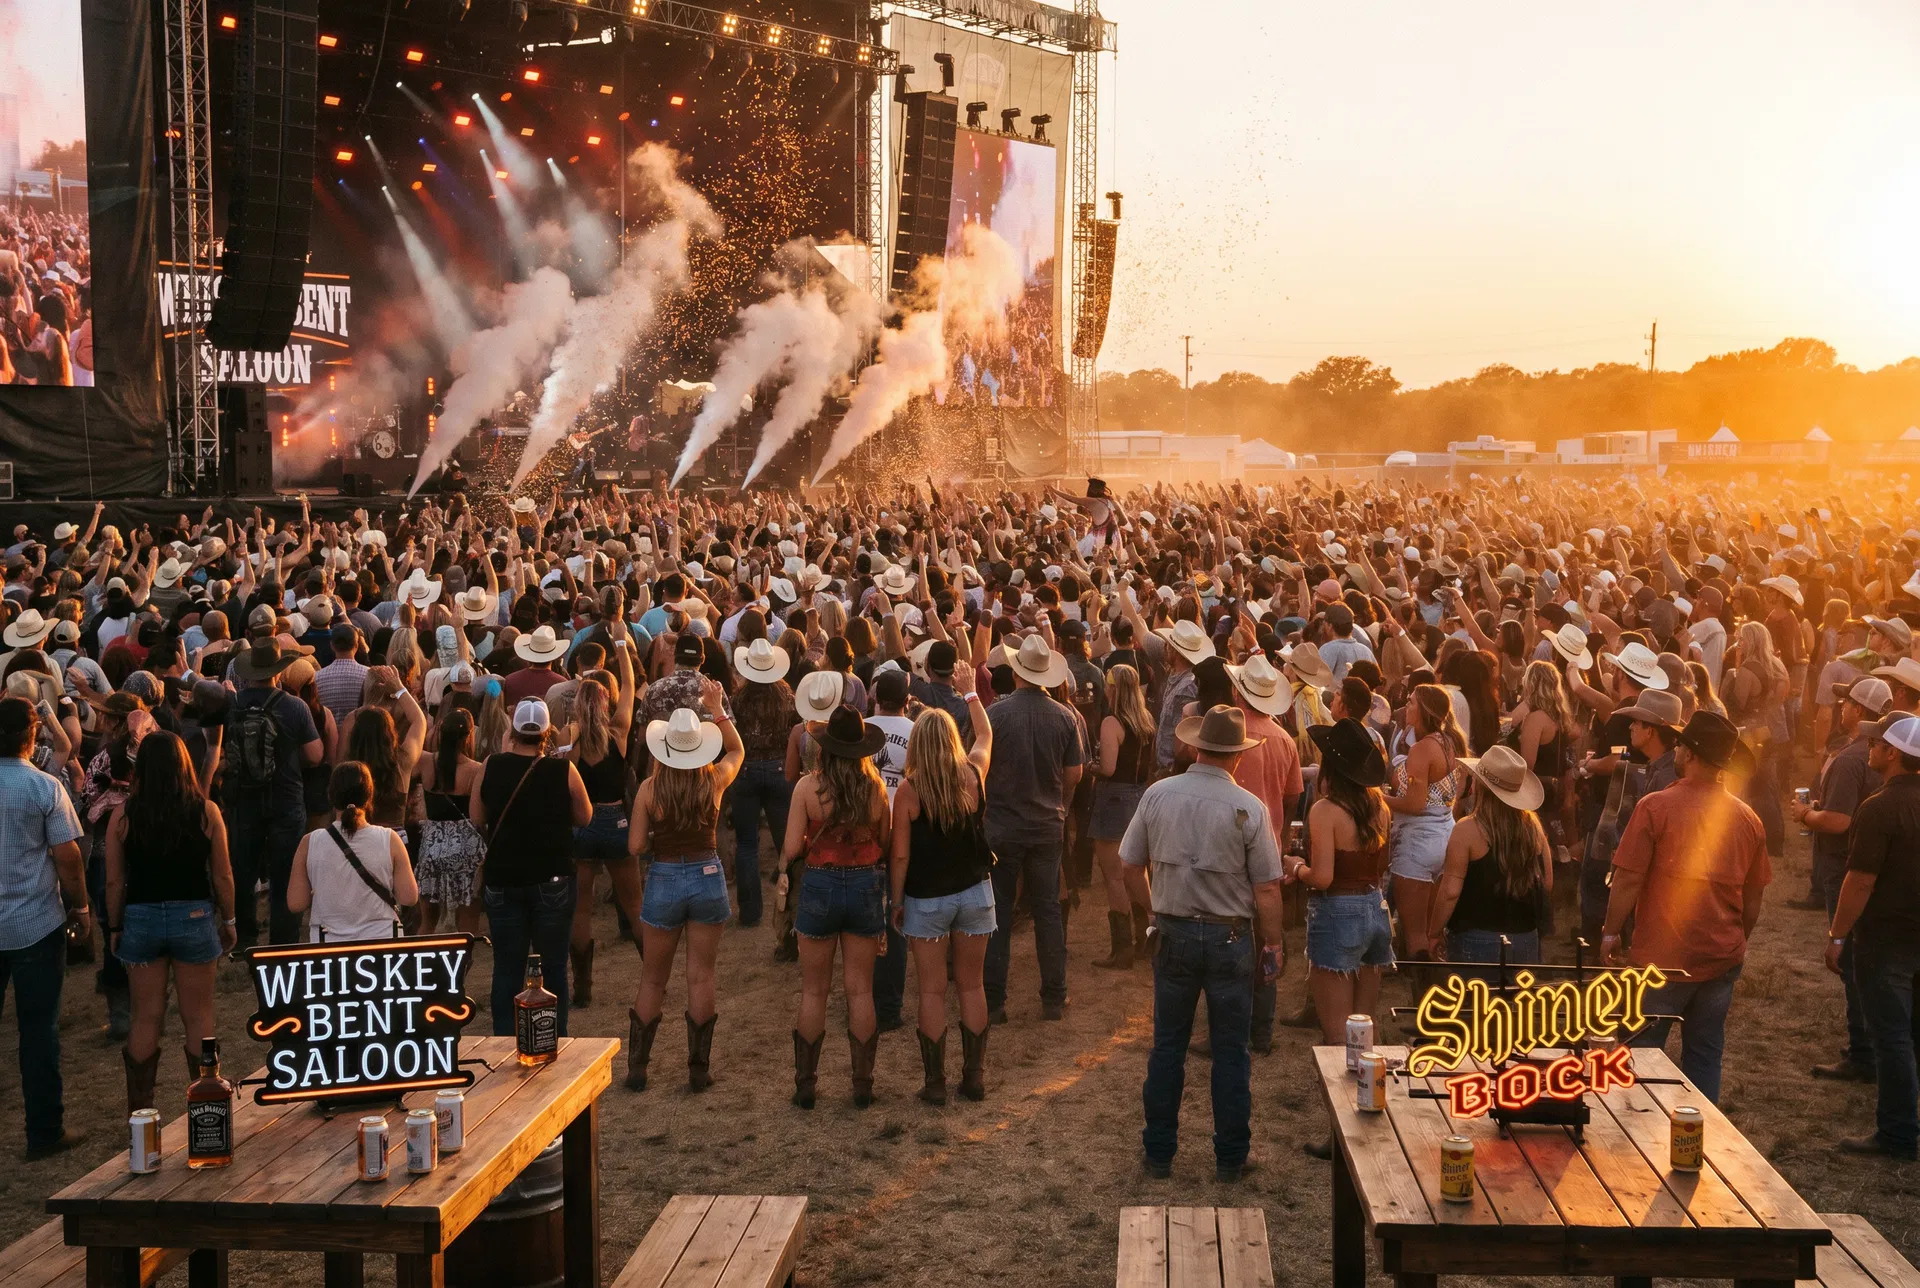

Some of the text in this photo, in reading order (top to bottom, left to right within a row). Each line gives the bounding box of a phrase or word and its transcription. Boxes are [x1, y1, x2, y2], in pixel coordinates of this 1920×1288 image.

[256, 950, 466, 1008] WHISKEY
[306, 997, 423, 1042] BENT
[1408, 963, 1668, 1078] Shiner
[273, 1036, 455, 1089] SALOON
[1445, 1044, 1635, 1119] BOCK
